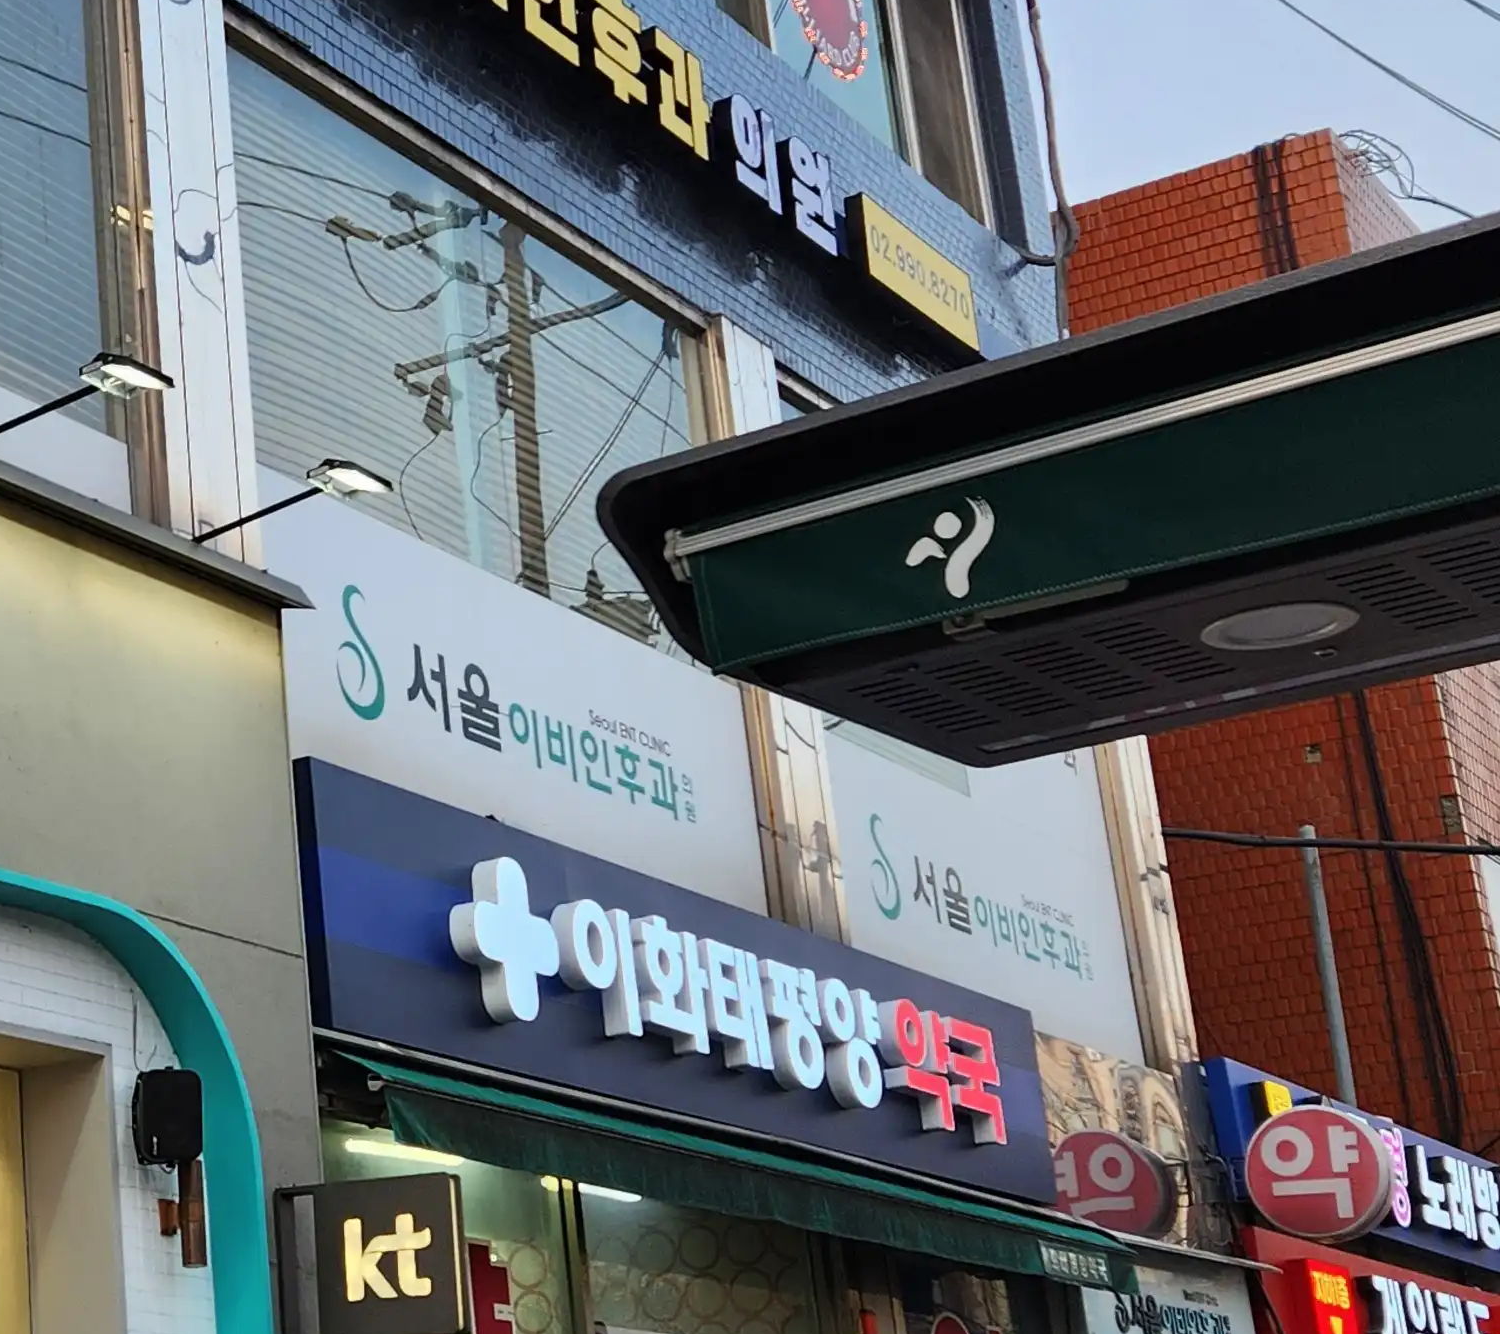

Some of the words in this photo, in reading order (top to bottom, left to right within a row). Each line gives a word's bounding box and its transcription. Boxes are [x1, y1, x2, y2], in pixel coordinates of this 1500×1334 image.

[731, 93, 839, 257] 의원
[1260, 1125, 1360, 1219] 약
[1415, 1144, 1500, 1251] 노래방
[342, 1212, 433, 1303] kt
